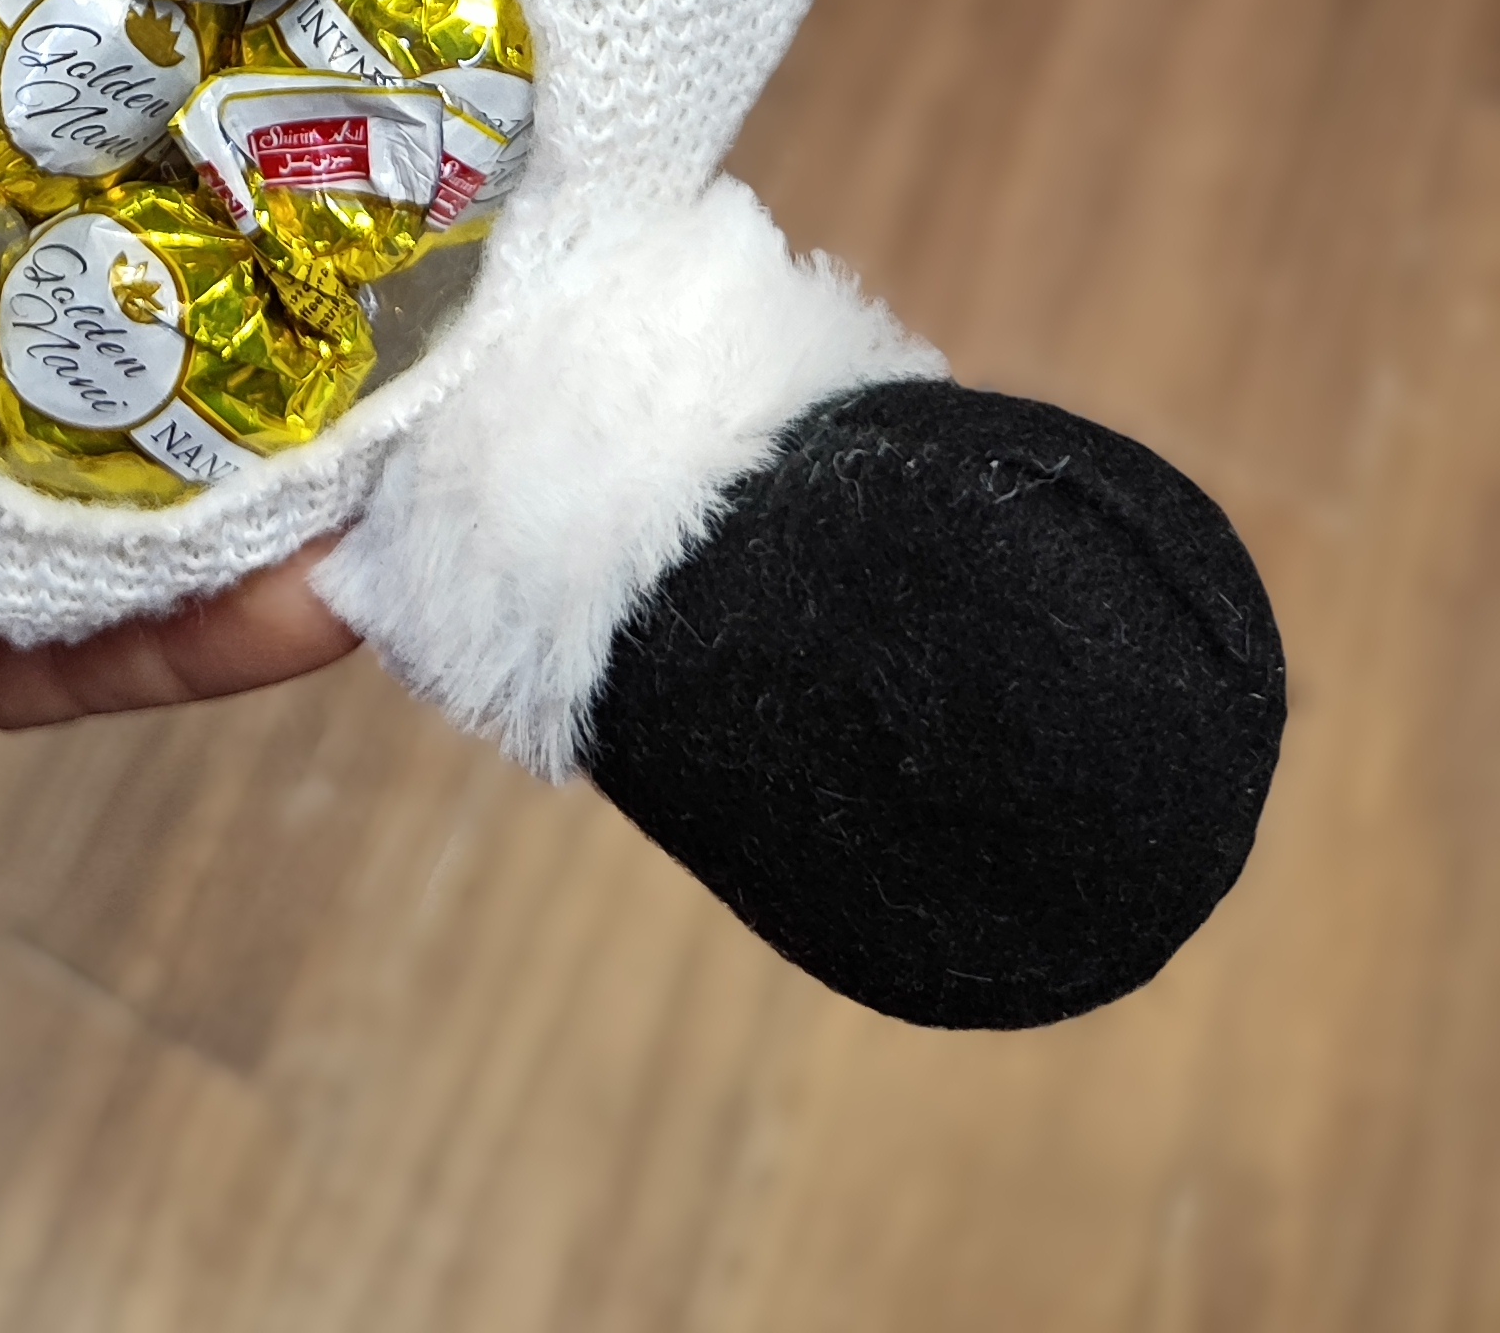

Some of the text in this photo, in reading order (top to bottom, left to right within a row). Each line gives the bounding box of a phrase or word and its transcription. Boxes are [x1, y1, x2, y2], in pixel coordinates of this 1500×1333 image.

[18, 23, 170, 119] Golden
[15, 80, 149, 159] Nani
[9, 293, 129, 414] Nani
[22, 243, 148, 379] Golden
[150, 419, 241, 481] NAN
